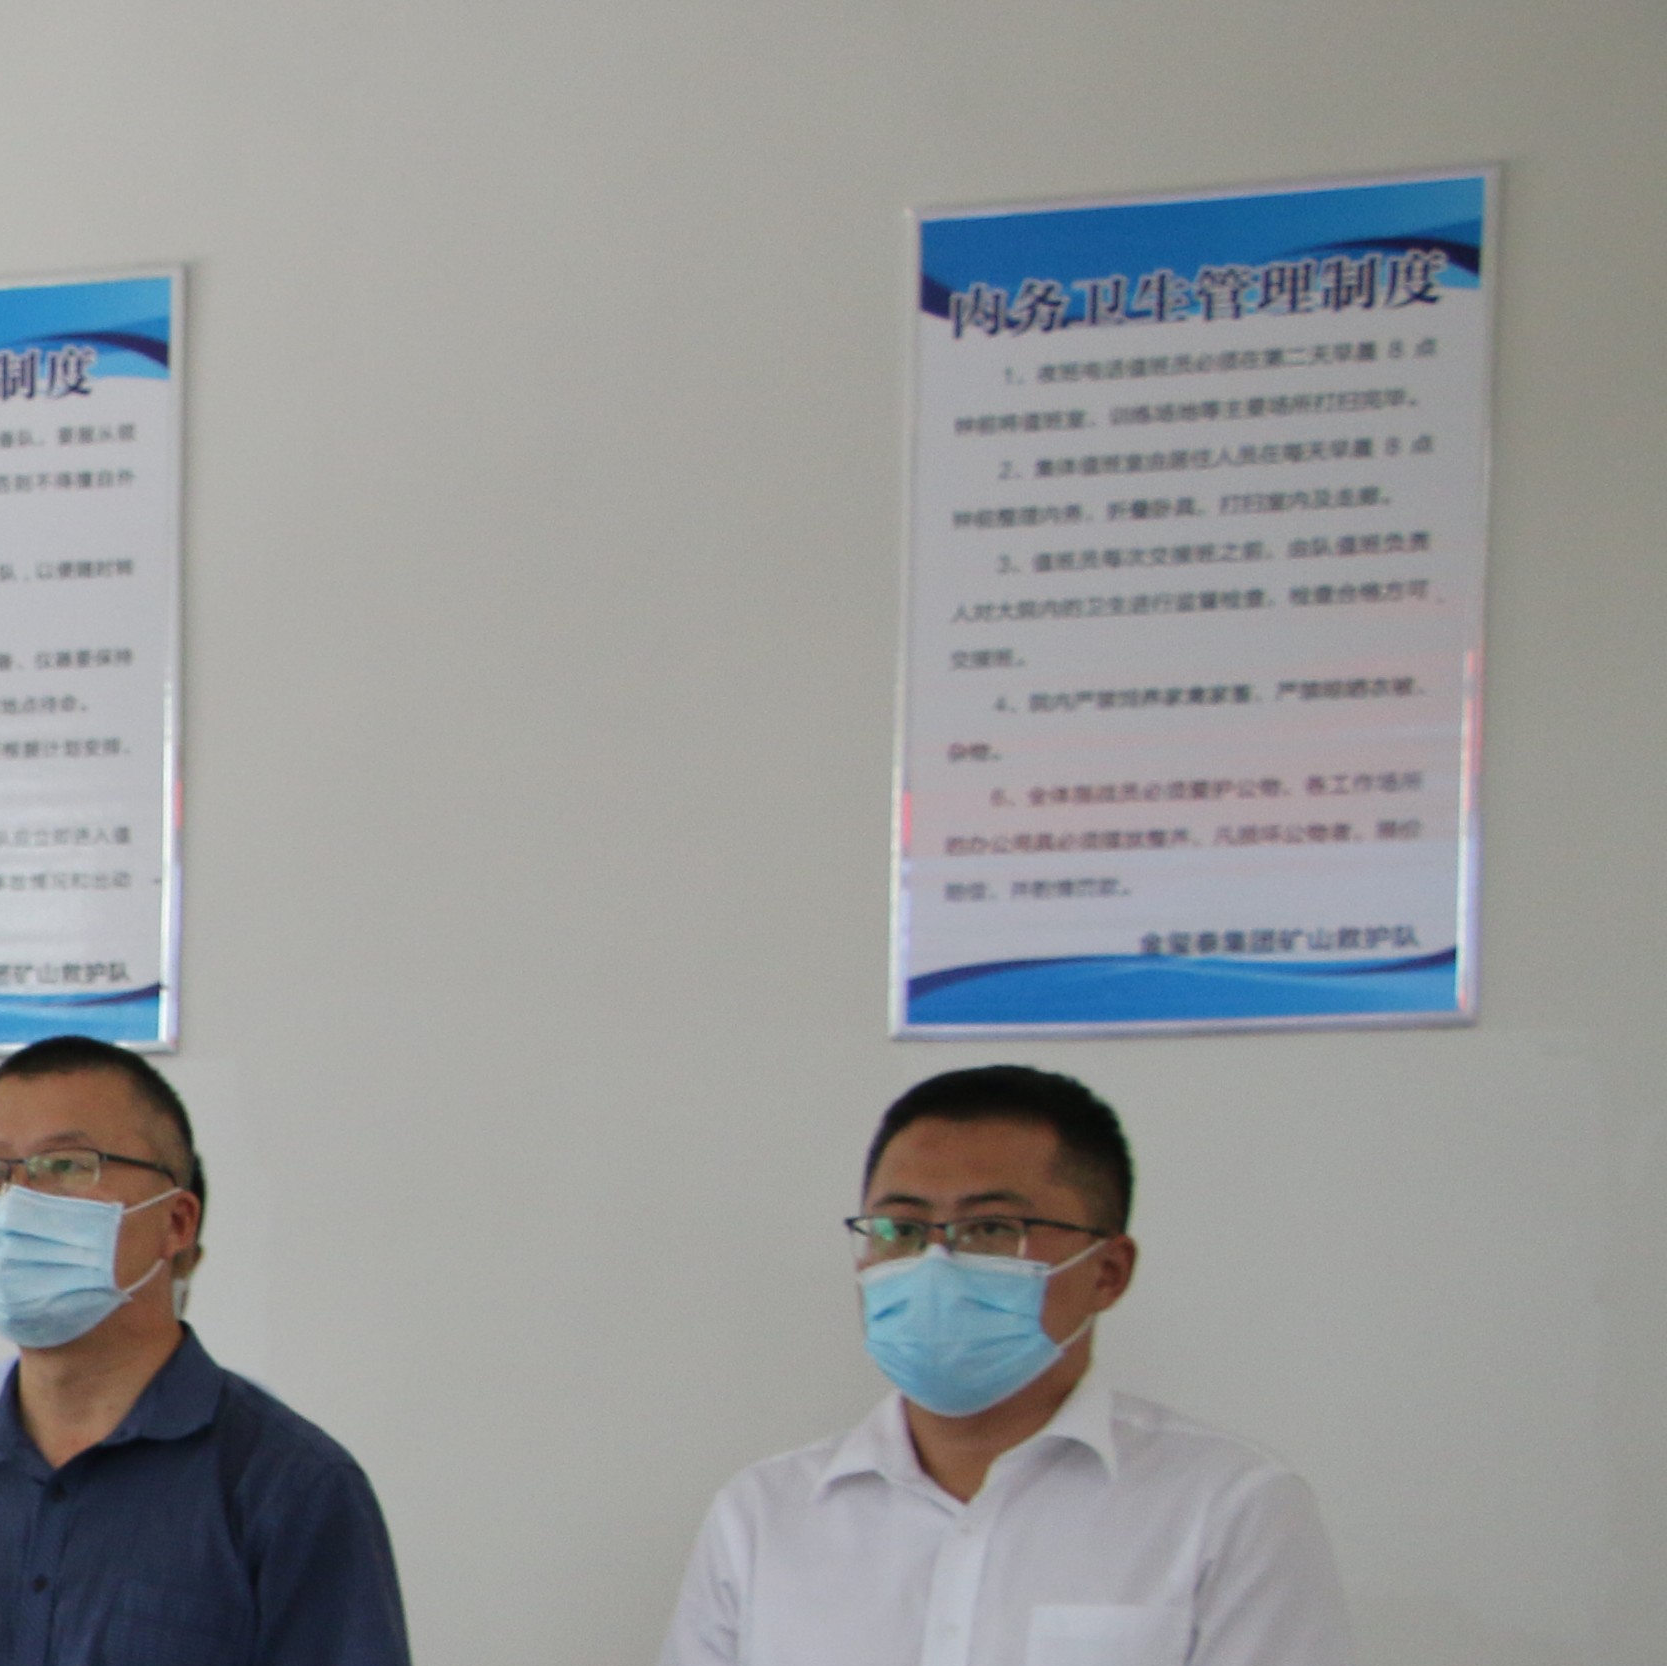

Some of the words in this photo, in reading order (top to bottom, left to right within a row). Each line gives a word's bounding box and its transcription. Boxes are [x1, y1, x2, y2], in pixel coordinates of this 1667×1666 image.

[949, 250, 1447, 338] 内务卫生管理制度
